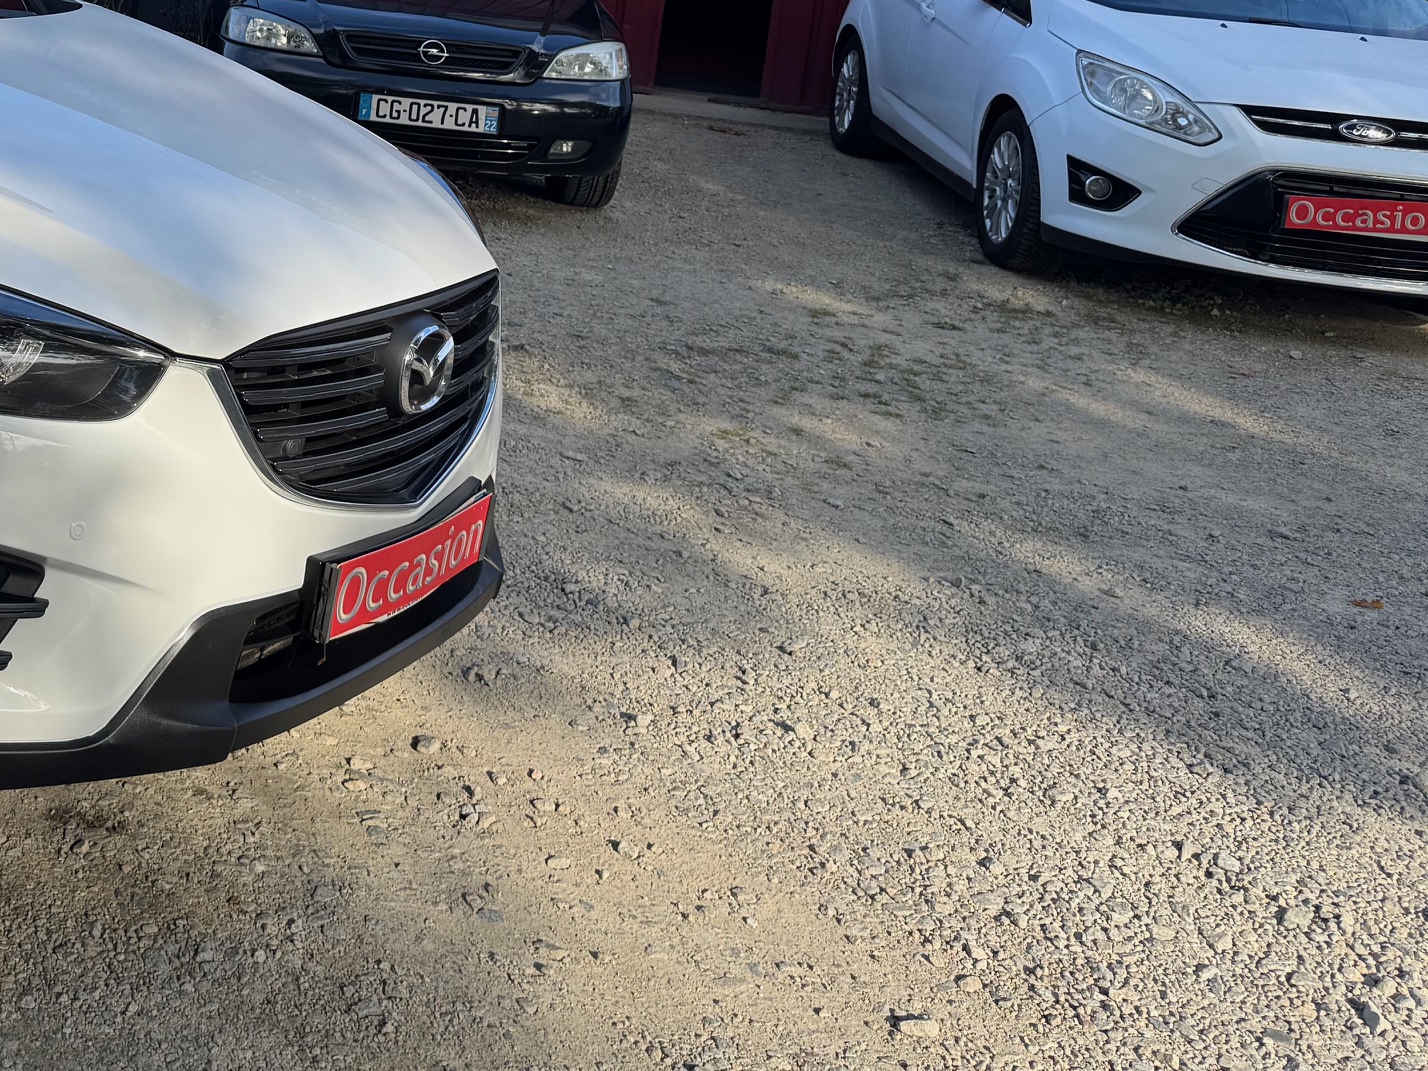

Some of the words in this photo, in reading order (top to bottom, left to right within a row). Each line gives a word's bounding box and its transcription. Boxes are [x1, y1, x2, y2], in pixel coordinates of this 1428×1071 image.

[375, 97, 480, 129] CG-027-CA
[484, 120, 497, 132] 22
[336, 518, 484, 624] Occasion
